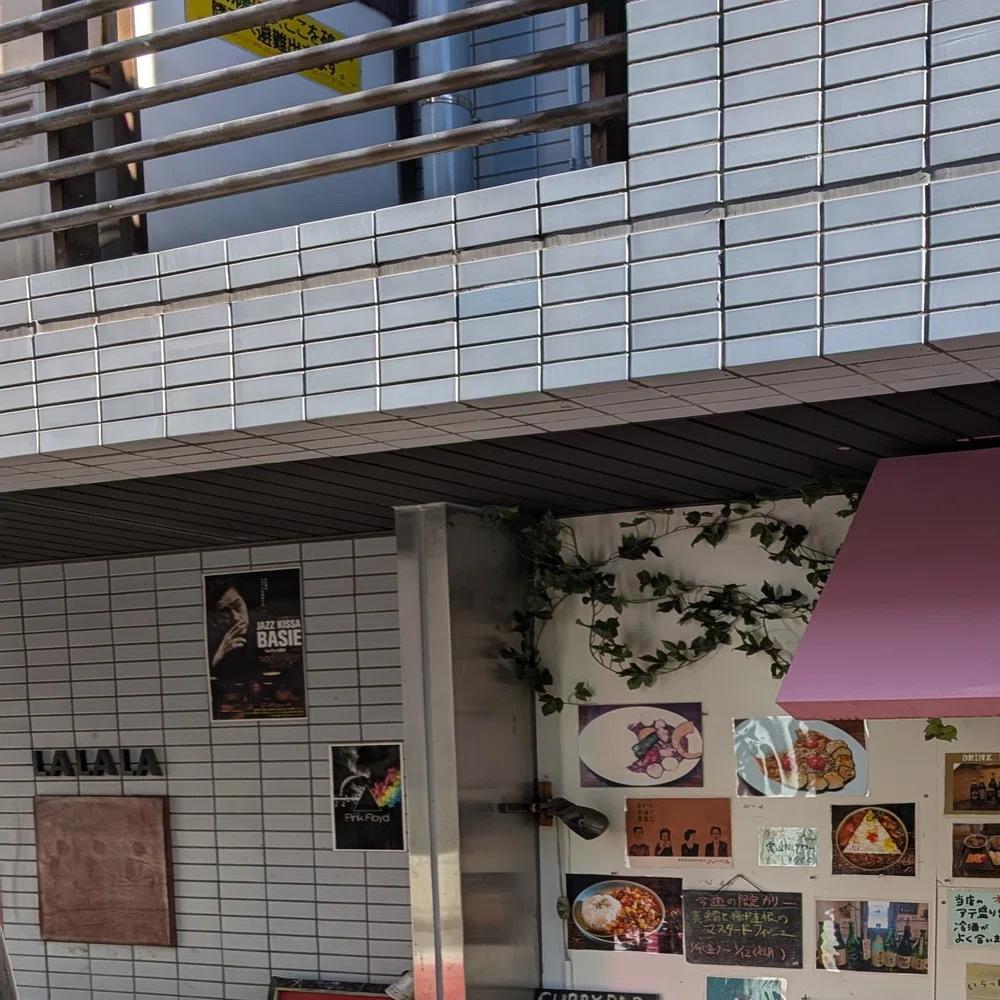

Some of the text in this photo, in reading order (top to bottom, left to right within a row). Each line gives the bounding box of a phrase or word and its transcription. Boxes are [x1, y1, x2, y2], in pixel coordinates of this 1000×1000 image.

[257, 618, 302, 631] JAZZ KISSA
[257, 629, 302, 649] BASIE
[962, 753, 993, 762] DRINK
[344, 812, 390, 824] Pink Floyd
[954, 894, 984, 907] 当店の
[953, 920, 990, 933] 冷酒が
